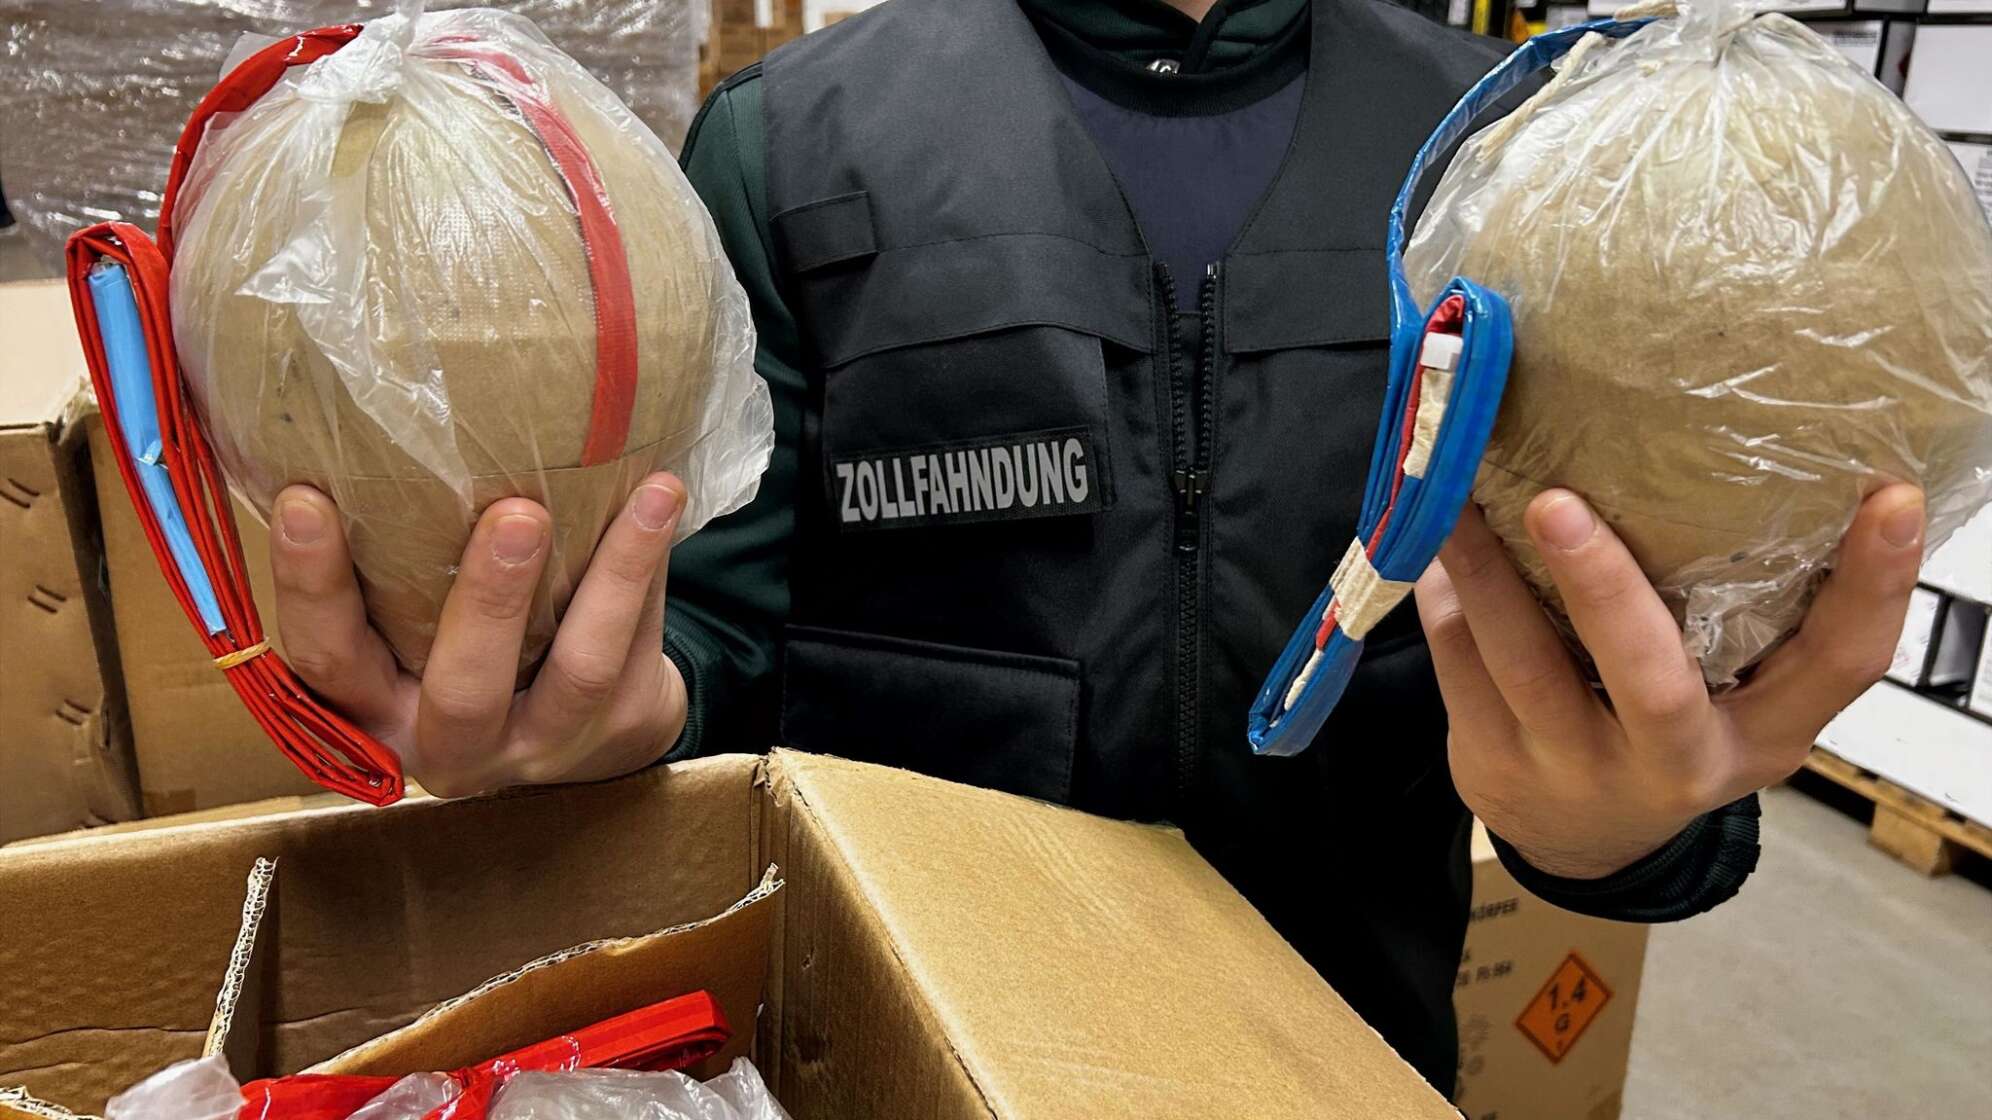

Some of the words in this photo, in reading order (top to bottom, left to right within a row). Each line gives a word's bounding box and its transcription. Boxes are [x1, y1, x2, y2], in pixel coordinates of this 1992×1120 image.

[836, 438, 1088, 522] ZOLLFAHNDUNG
[1550, 976, 1587, 1010] 1.4
[1554, 1012, 1570, 1033] G
